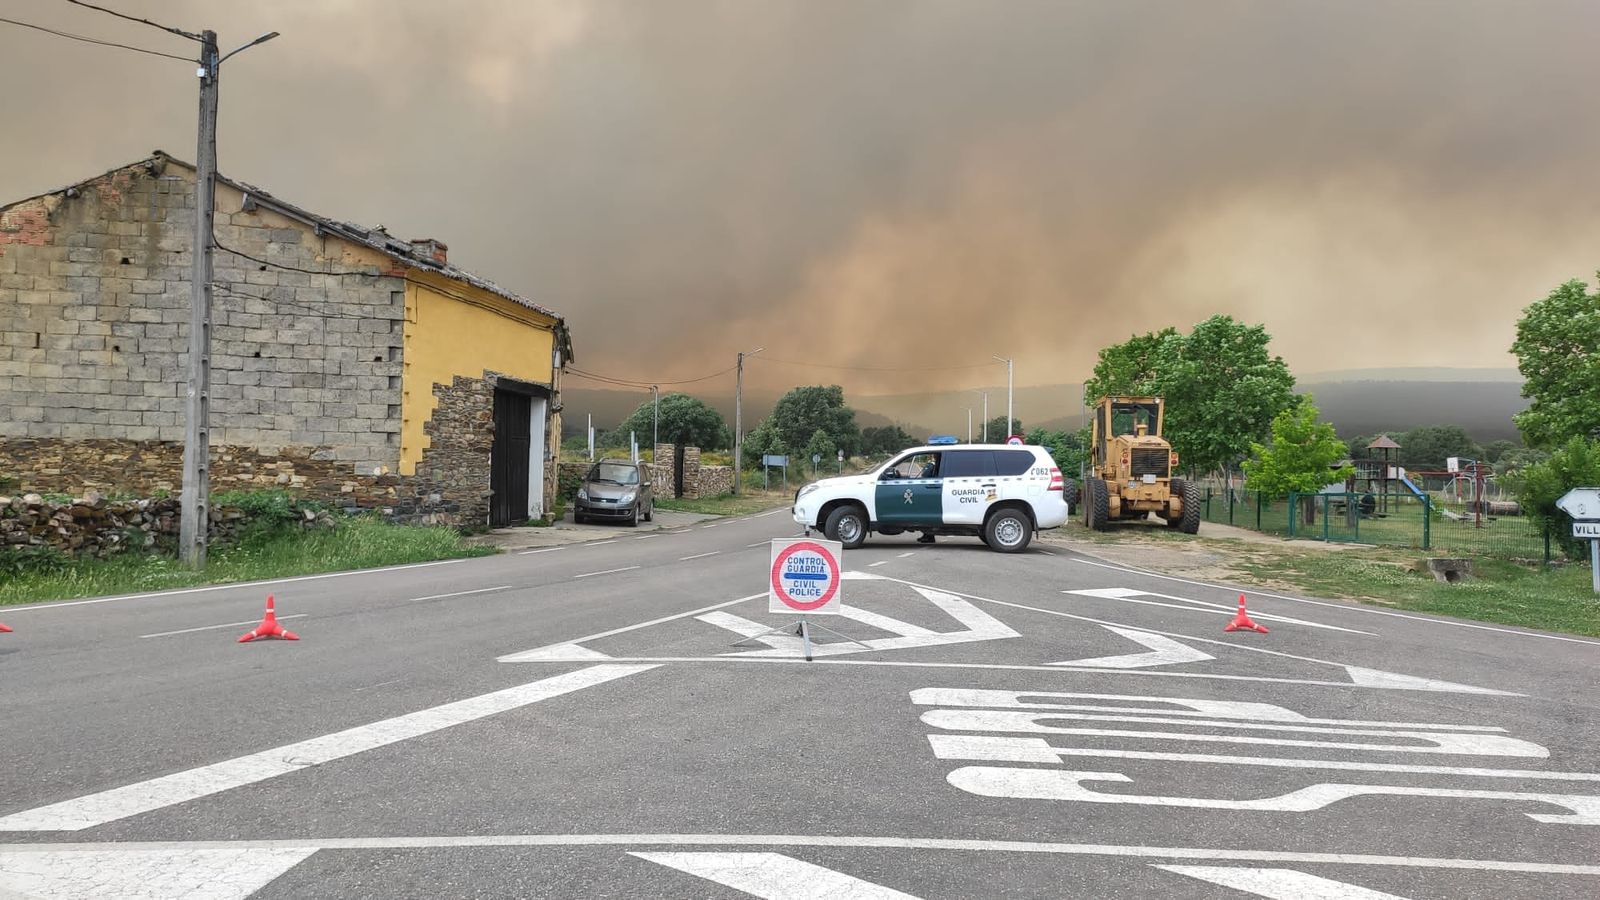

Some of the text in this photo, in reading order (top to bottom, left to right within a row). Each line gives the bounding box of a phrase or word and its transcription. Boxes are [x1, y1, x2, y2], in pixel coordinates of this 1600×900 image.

[787, 557, 826, 566] CONTROL
[787, 565, 825, 573] GUARDIA
[793, 580, 817, 588] CIVIL
[789, 588, 821, 596] POLICE
[909, 687, 1600, 826] STOP
